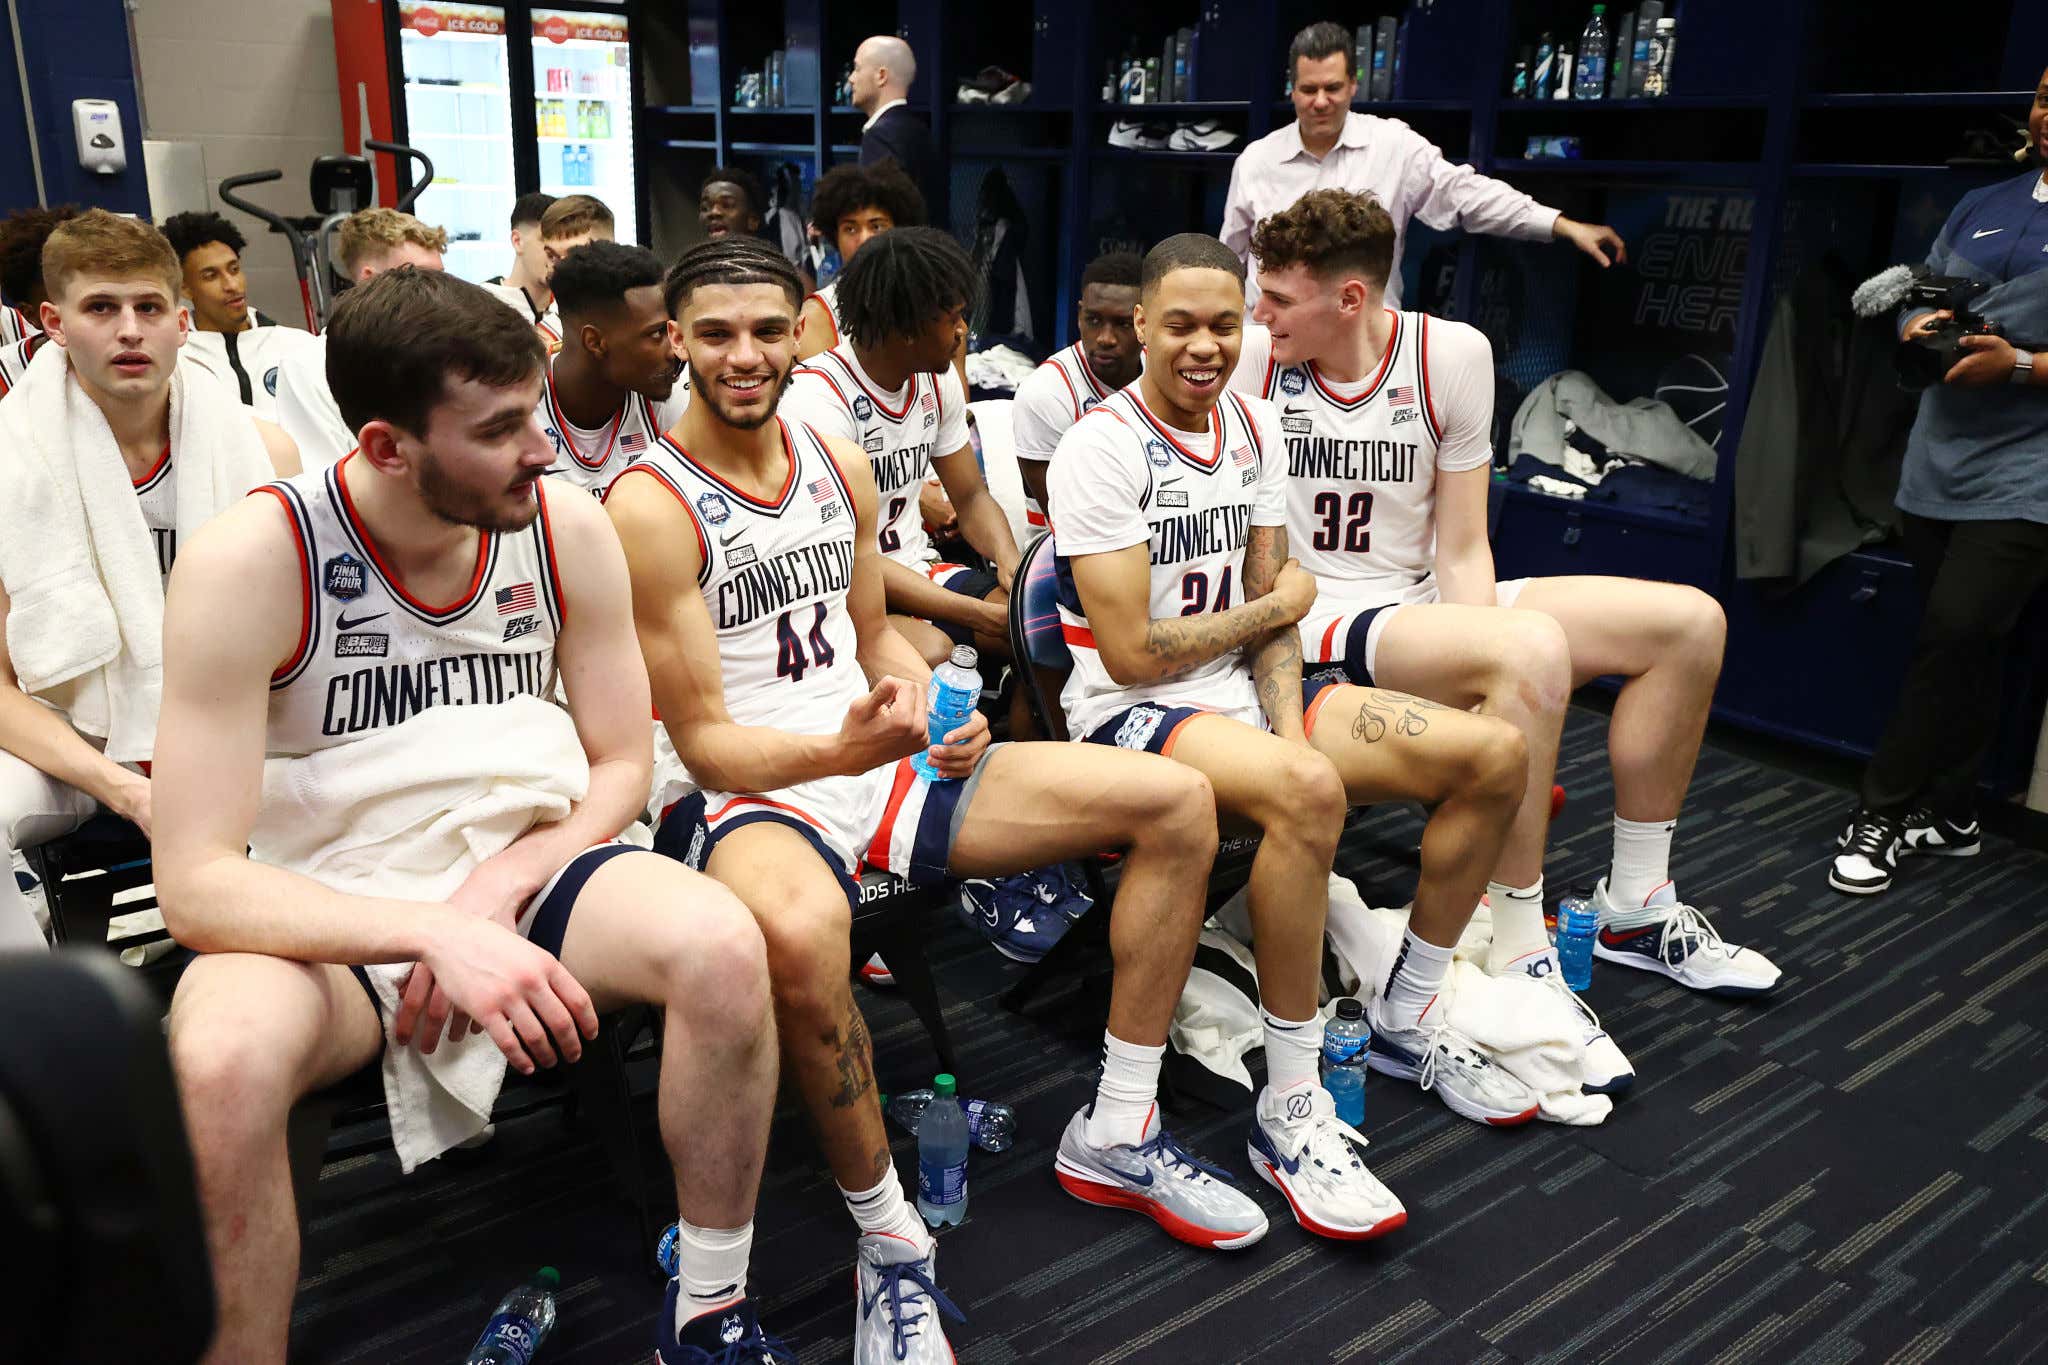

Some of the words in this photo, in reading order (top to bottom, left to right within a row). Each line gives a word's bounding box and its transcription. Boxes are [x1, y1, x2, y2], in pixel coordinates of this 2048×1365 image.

[447, 19, 464, 31] ICE
[468, 20, 499, 33] COLD
[575, 28, 592, 39] ICE
[595, 29, 623, 41] COLD
[1664, 195, 1714, 230] THE
[1285, 437, 1418, 483] ONNECTICUT
[1242, 472, 1257, 484] EAS
[820, 501, 836, 513] BIG
[821, 506, 842, 520] EAST
[878, 497, 907, 554] 2
[1313, 491, 1374, 553] 32
[332, 564, 361, 578] FINAL
[334, 576, 363, 590] FOUR
[506, 614, 534, 629] BIG
[503, 620, 542, 638] EAST
[776, 602, 835, 682] 44
[337, 645, 386, 655] CHANGE
[321, 652, 540, 736] CONNECTICU
